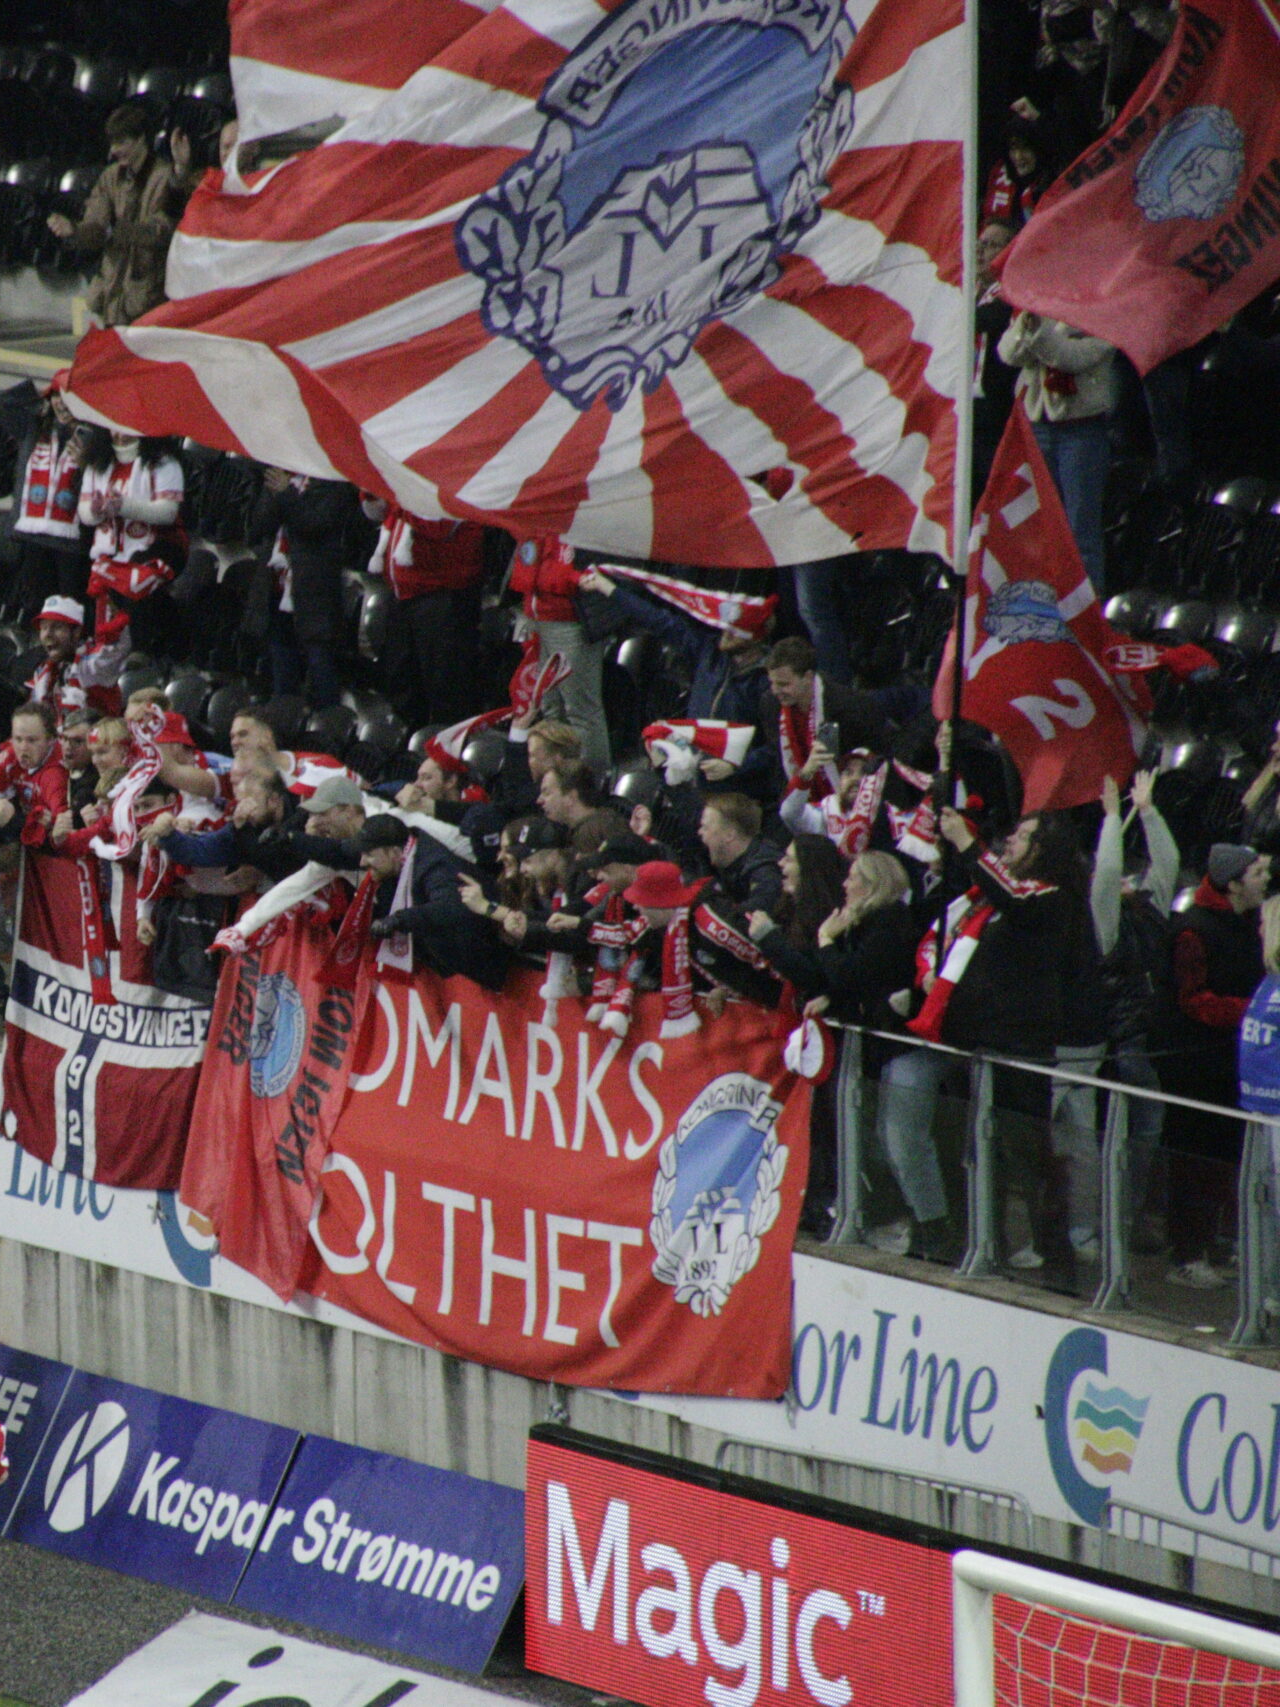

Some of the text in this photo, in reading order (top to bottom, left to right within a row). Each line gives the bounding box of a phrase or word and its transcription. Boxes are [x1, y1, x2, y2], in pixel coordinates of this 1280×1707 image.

[308, 1151, 644, 1348] OLTHET
[860, 1309, 999, 1454] Line
[128, 1451, 295, 1555] Kaspar
[292, 1498, 502, 1613] Strømme
[546, 1480, 854, 1707] Magic
